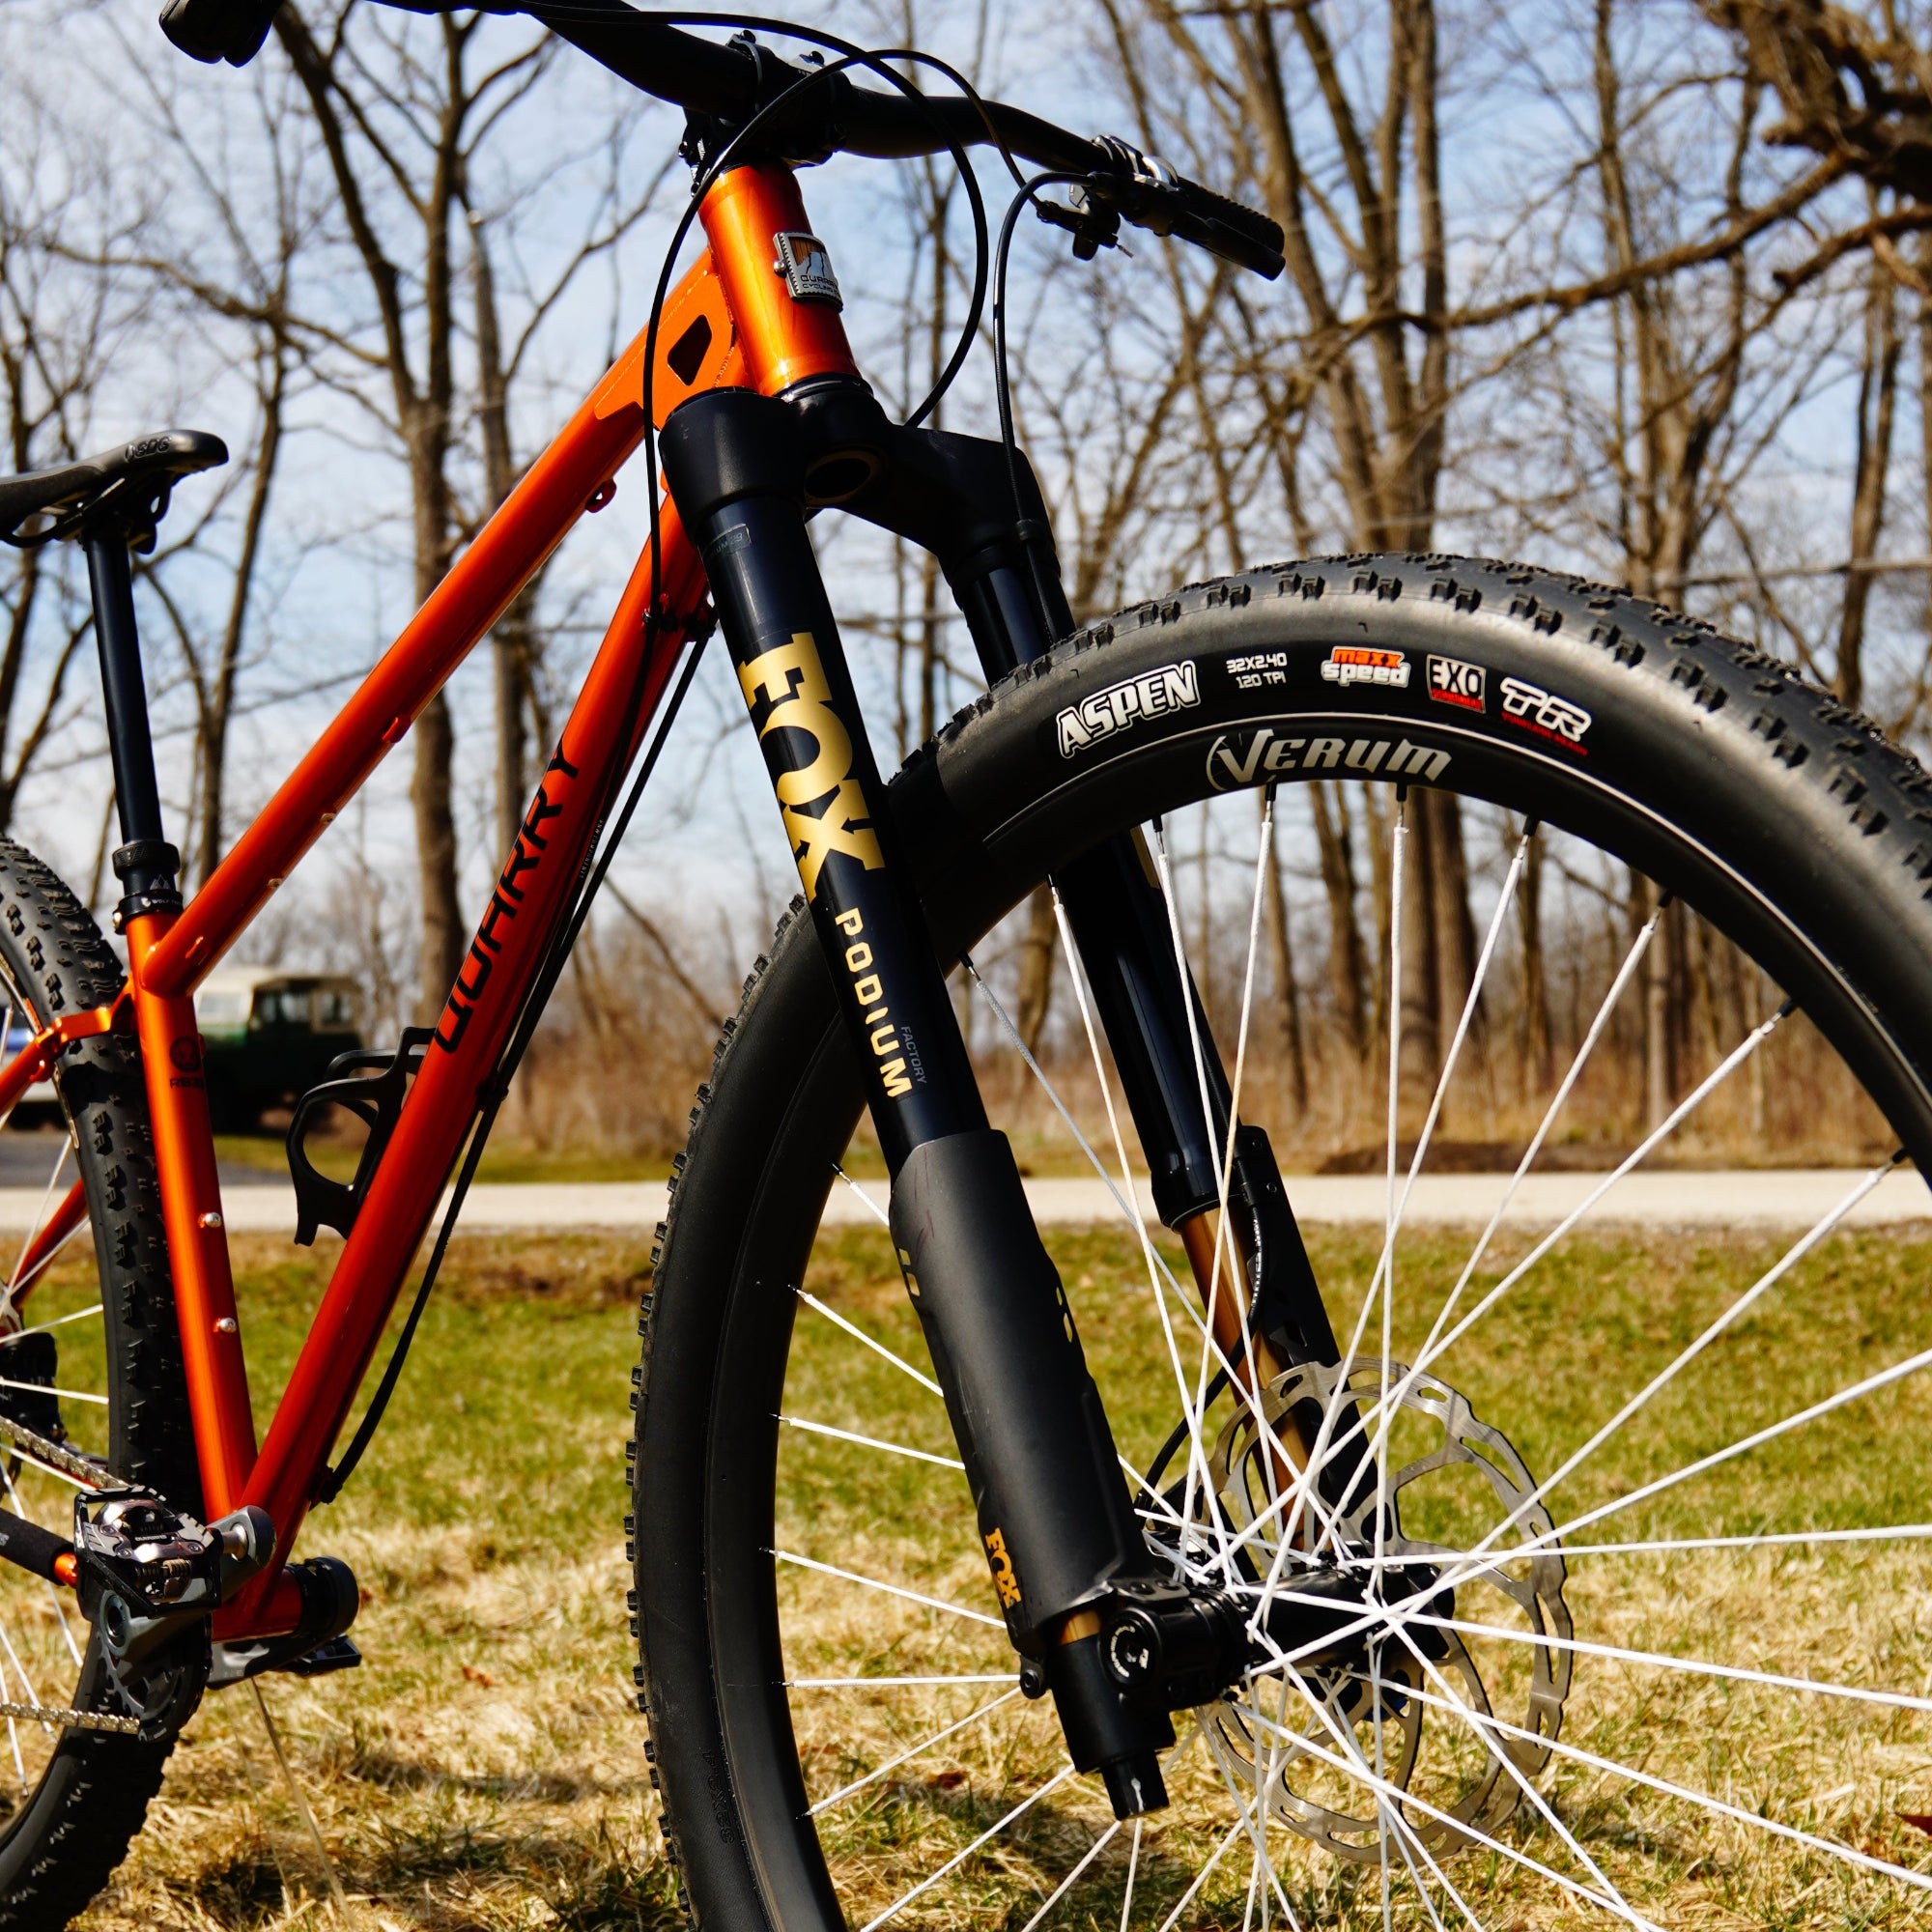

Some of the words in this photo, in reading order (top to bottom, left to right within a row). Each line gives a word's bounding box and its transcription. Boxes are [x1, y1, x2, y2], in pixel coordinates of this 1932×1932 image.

[1226, 652, 1288, 674] 32X2.40
[1236, 673, 1262, 689] 120
[1263, 670, 1287, 687] TPI
[1321, 662, 1411, 689] speed
[1332, 647, 1403, 669] maxx
[1431, 659, 1482, 698] EXO
[1056, 660, 1201, 758] ASPEN
[1500, 677, 1592, 743] TR
[737, 632, 886, 905] FOX
[434, 738, 580, 1055] QUARRY
[835, 907, 913, 1098] PODIUM
[900, 1026, 927, 1084] FACTORY
[985, 1527, 1022, 1609] FOX
